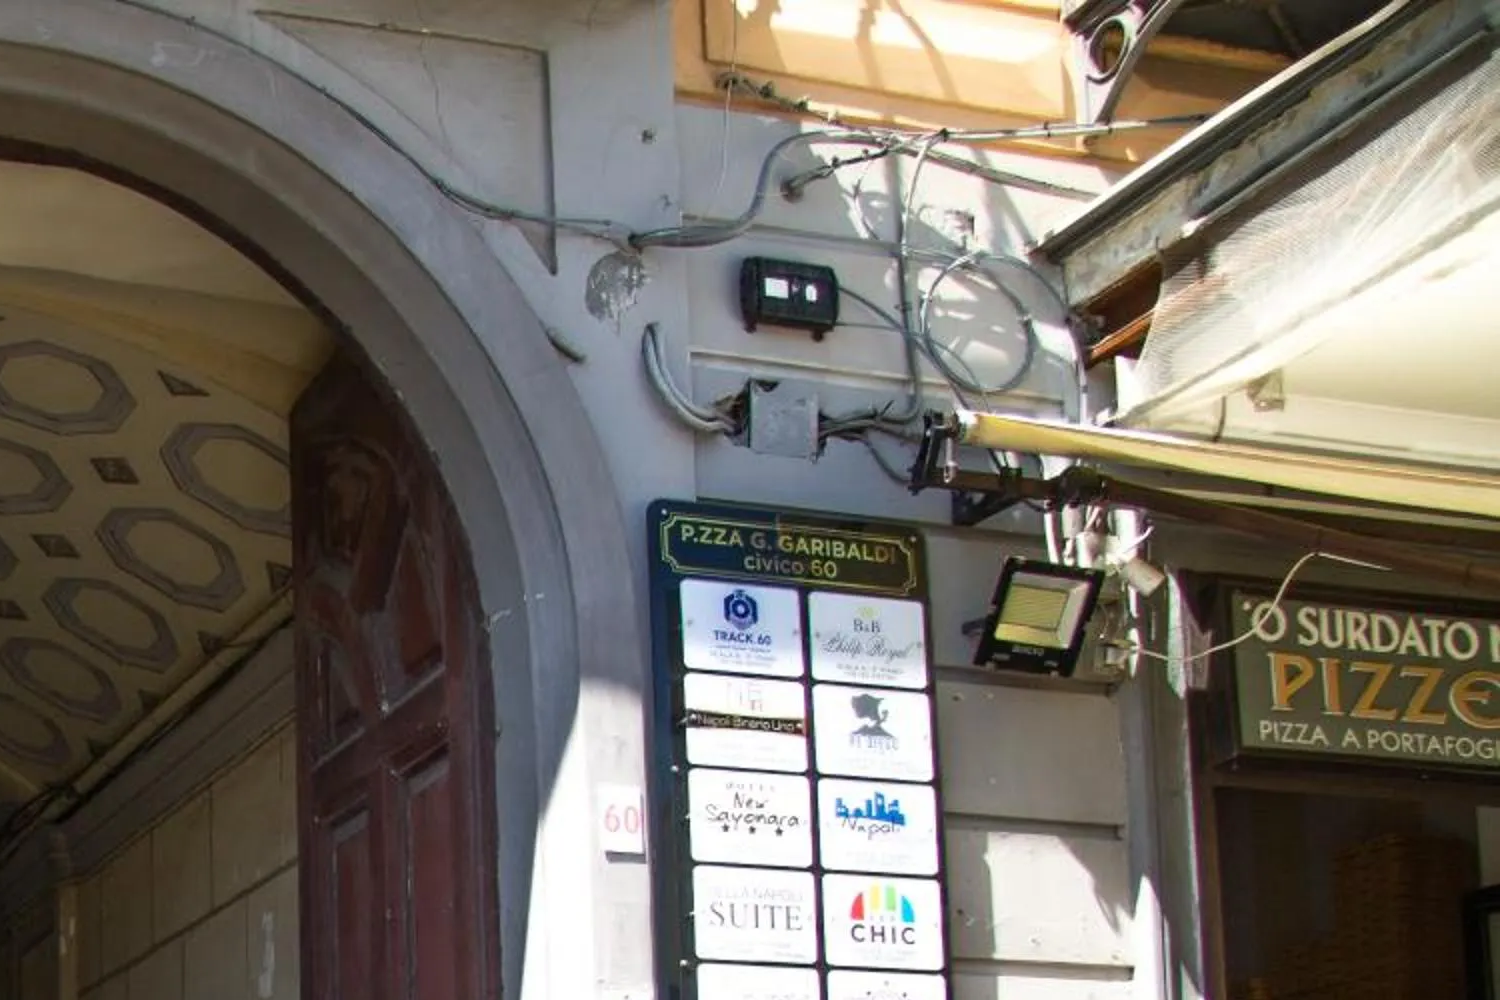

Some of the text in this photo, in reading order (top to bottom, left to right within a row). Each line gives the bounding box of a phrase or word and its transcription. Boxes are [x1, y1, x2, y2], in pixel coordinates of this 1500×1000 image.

[680, 524, 897, 565] P.ZZA G. GARIBALDI
[743, 553, 838, 579] civico 60
[1297, 606, 1479, 662] SURDATO
[1259, 720, 1329, 746] PIZZA
[1342, 727, 1362, 749] A
[733, 792, 771, 809] New
[604, 804, 642, 834] 60
[705, 803, 800, 832] Sayonara
[709, 902, 803, 931] SUITE
[850, 923, 916, 945] CHIC
